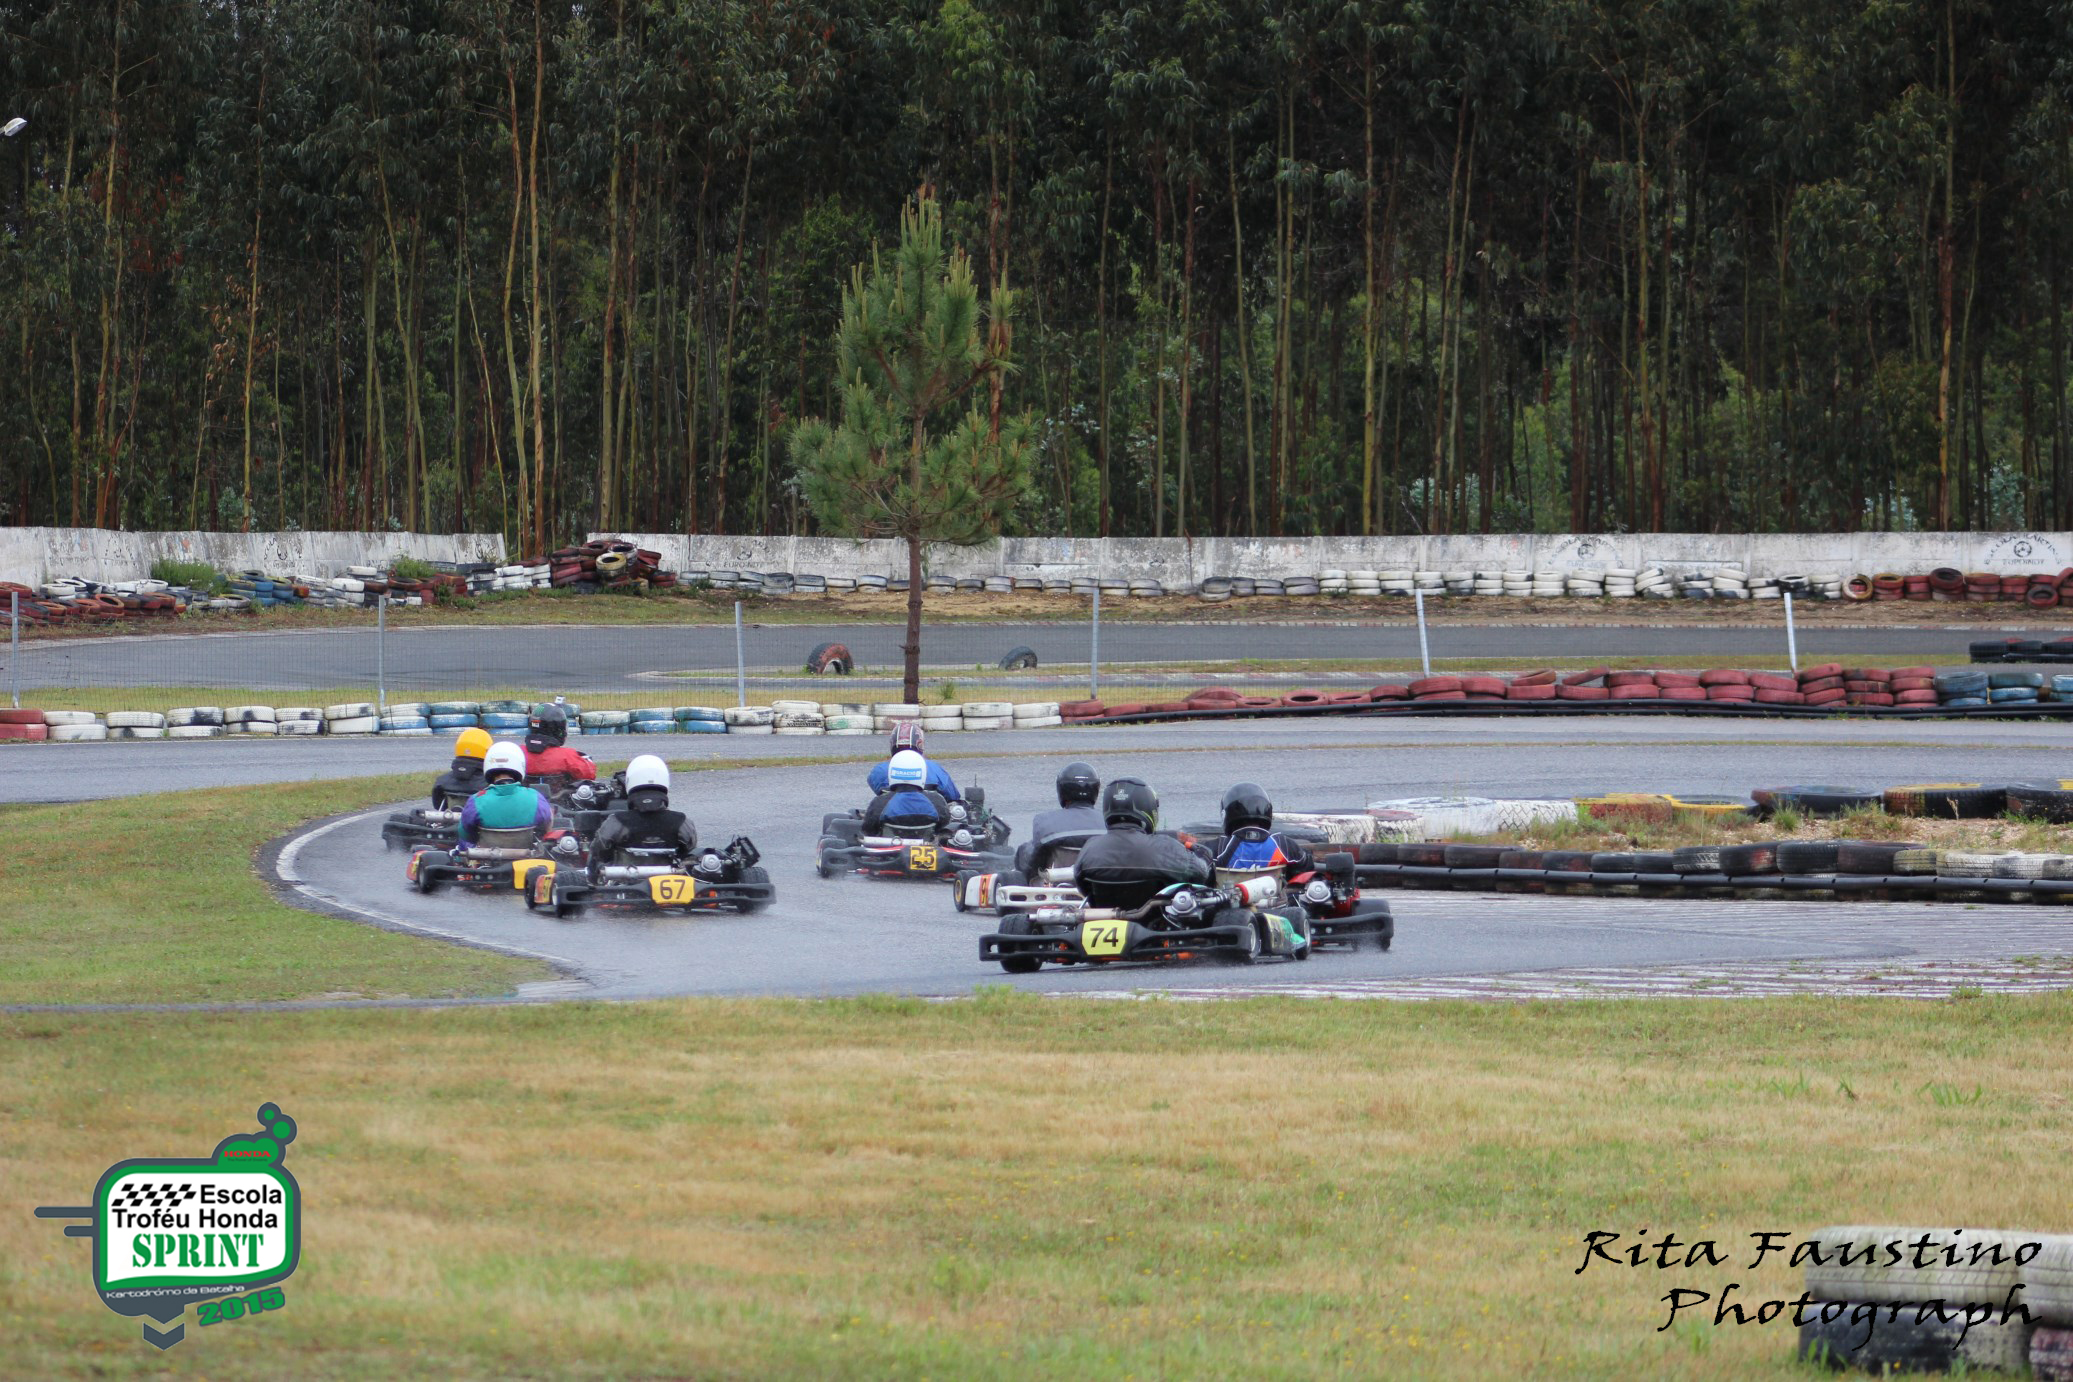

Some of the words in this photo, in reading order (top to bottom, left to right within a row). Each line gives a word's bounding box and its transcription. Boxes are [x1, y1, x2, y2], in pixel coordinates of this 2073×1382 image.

[911, 847, 935, 865] 25
[660, 879, 686, 900] 67
[1090, 927, 1119, 948] 74
